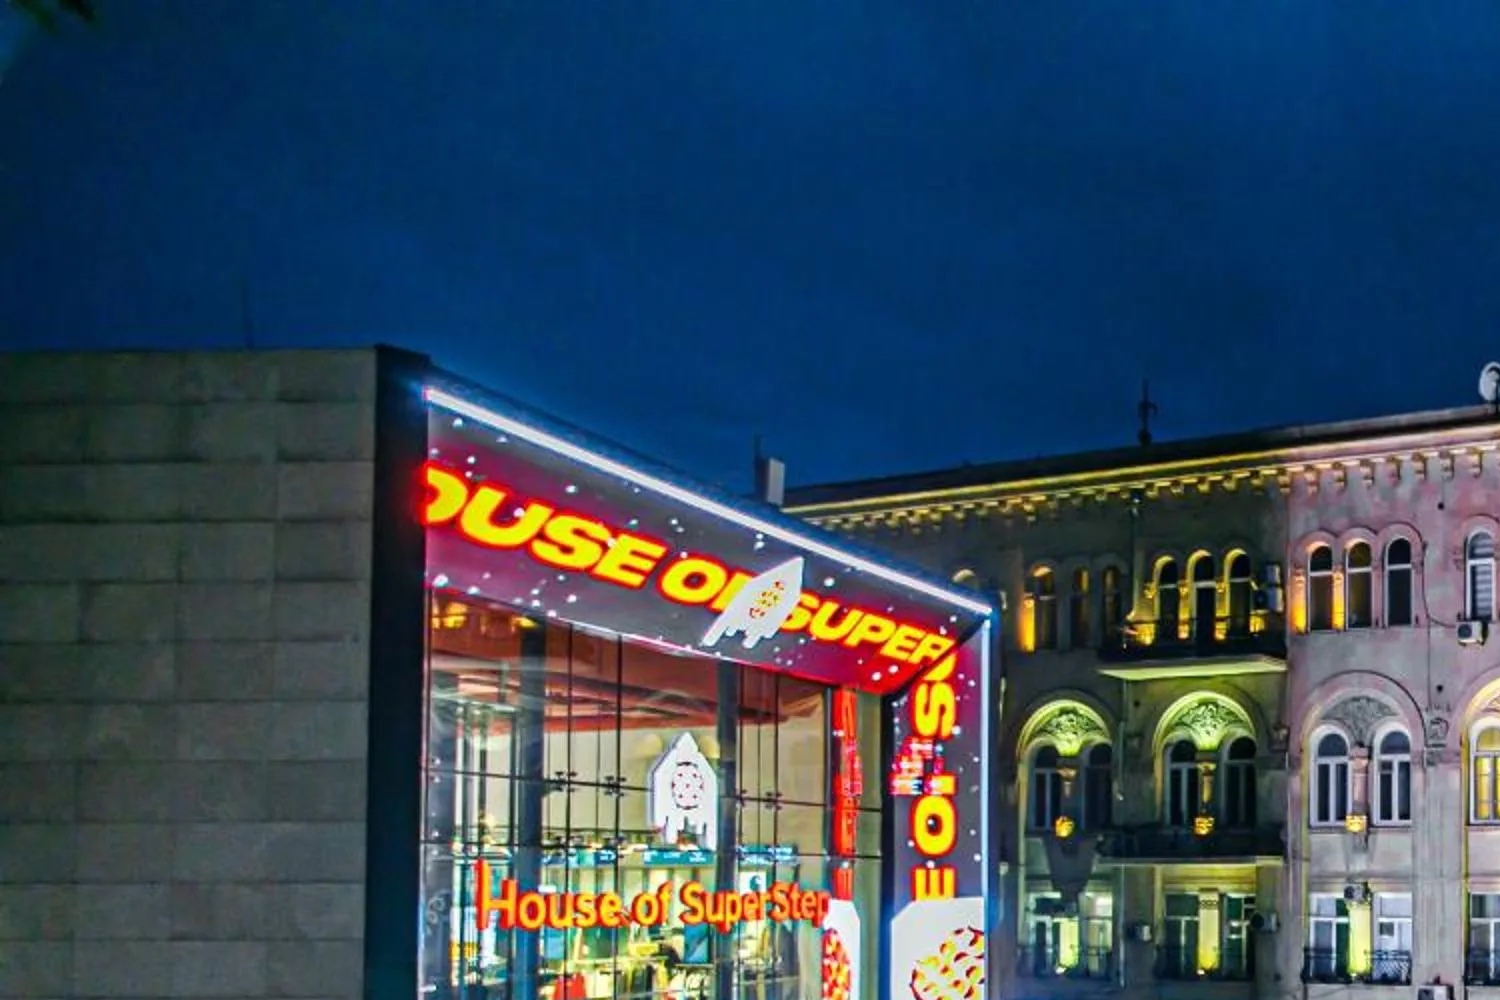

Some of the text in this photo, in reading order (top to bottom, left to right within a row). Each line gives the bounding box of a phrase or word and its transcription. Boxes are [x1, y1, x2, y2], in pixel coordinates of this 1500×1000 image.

[475, 857, 830, 934] House of SuperStep
